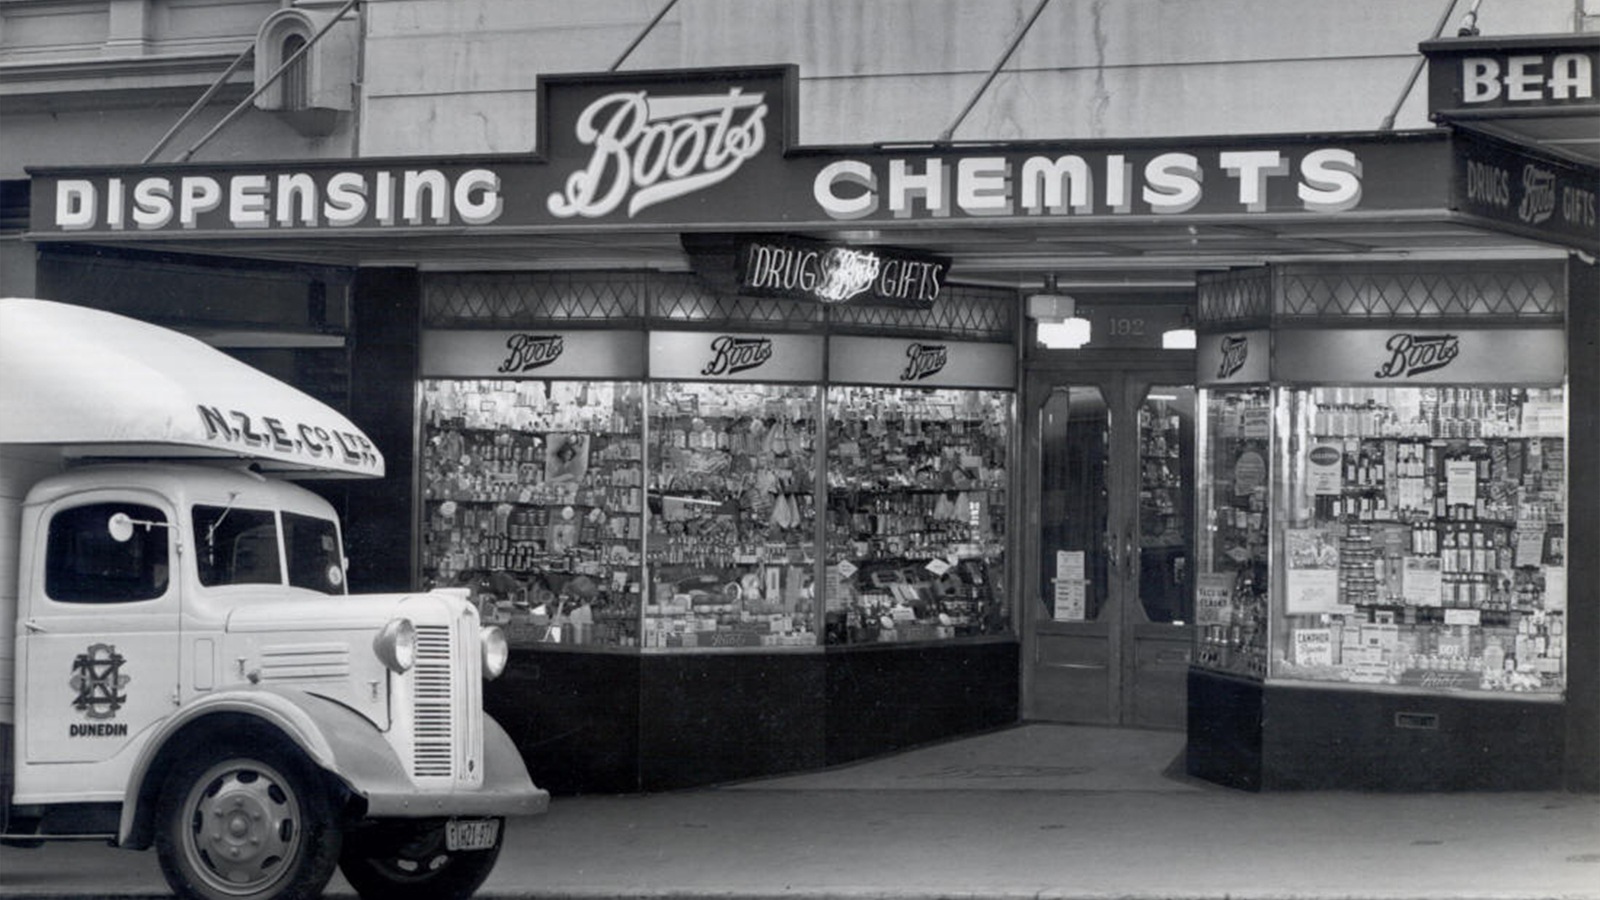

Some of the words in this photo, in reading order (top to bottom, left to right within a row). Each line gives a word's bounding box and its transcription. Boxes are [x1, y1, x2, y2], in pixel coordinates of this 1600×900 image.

[1463, 53, 1592, 103] BEA
[547, 87, 769, 219] Boots
[55, 168, 503, 230] DISPENSING
[813, 148, 1363, 220] CHEMISTS
[1466, 159, 1510, 207] DRUGS
[1518, 163, 1557, 225] Boots
[1562, 186, 1596, 227] GIFTS
[880, 260, 943, 301] GIFTS
[1109, 317, 1145, 336] 192
[498, 333, 564, 372] Boots
[701, 335, 772, 375] Boots
[900, 342, 947, 381] Boots
[1374, 333, 1459, 378] Boots
[69, 723, 128, 737] DUNEDIN
